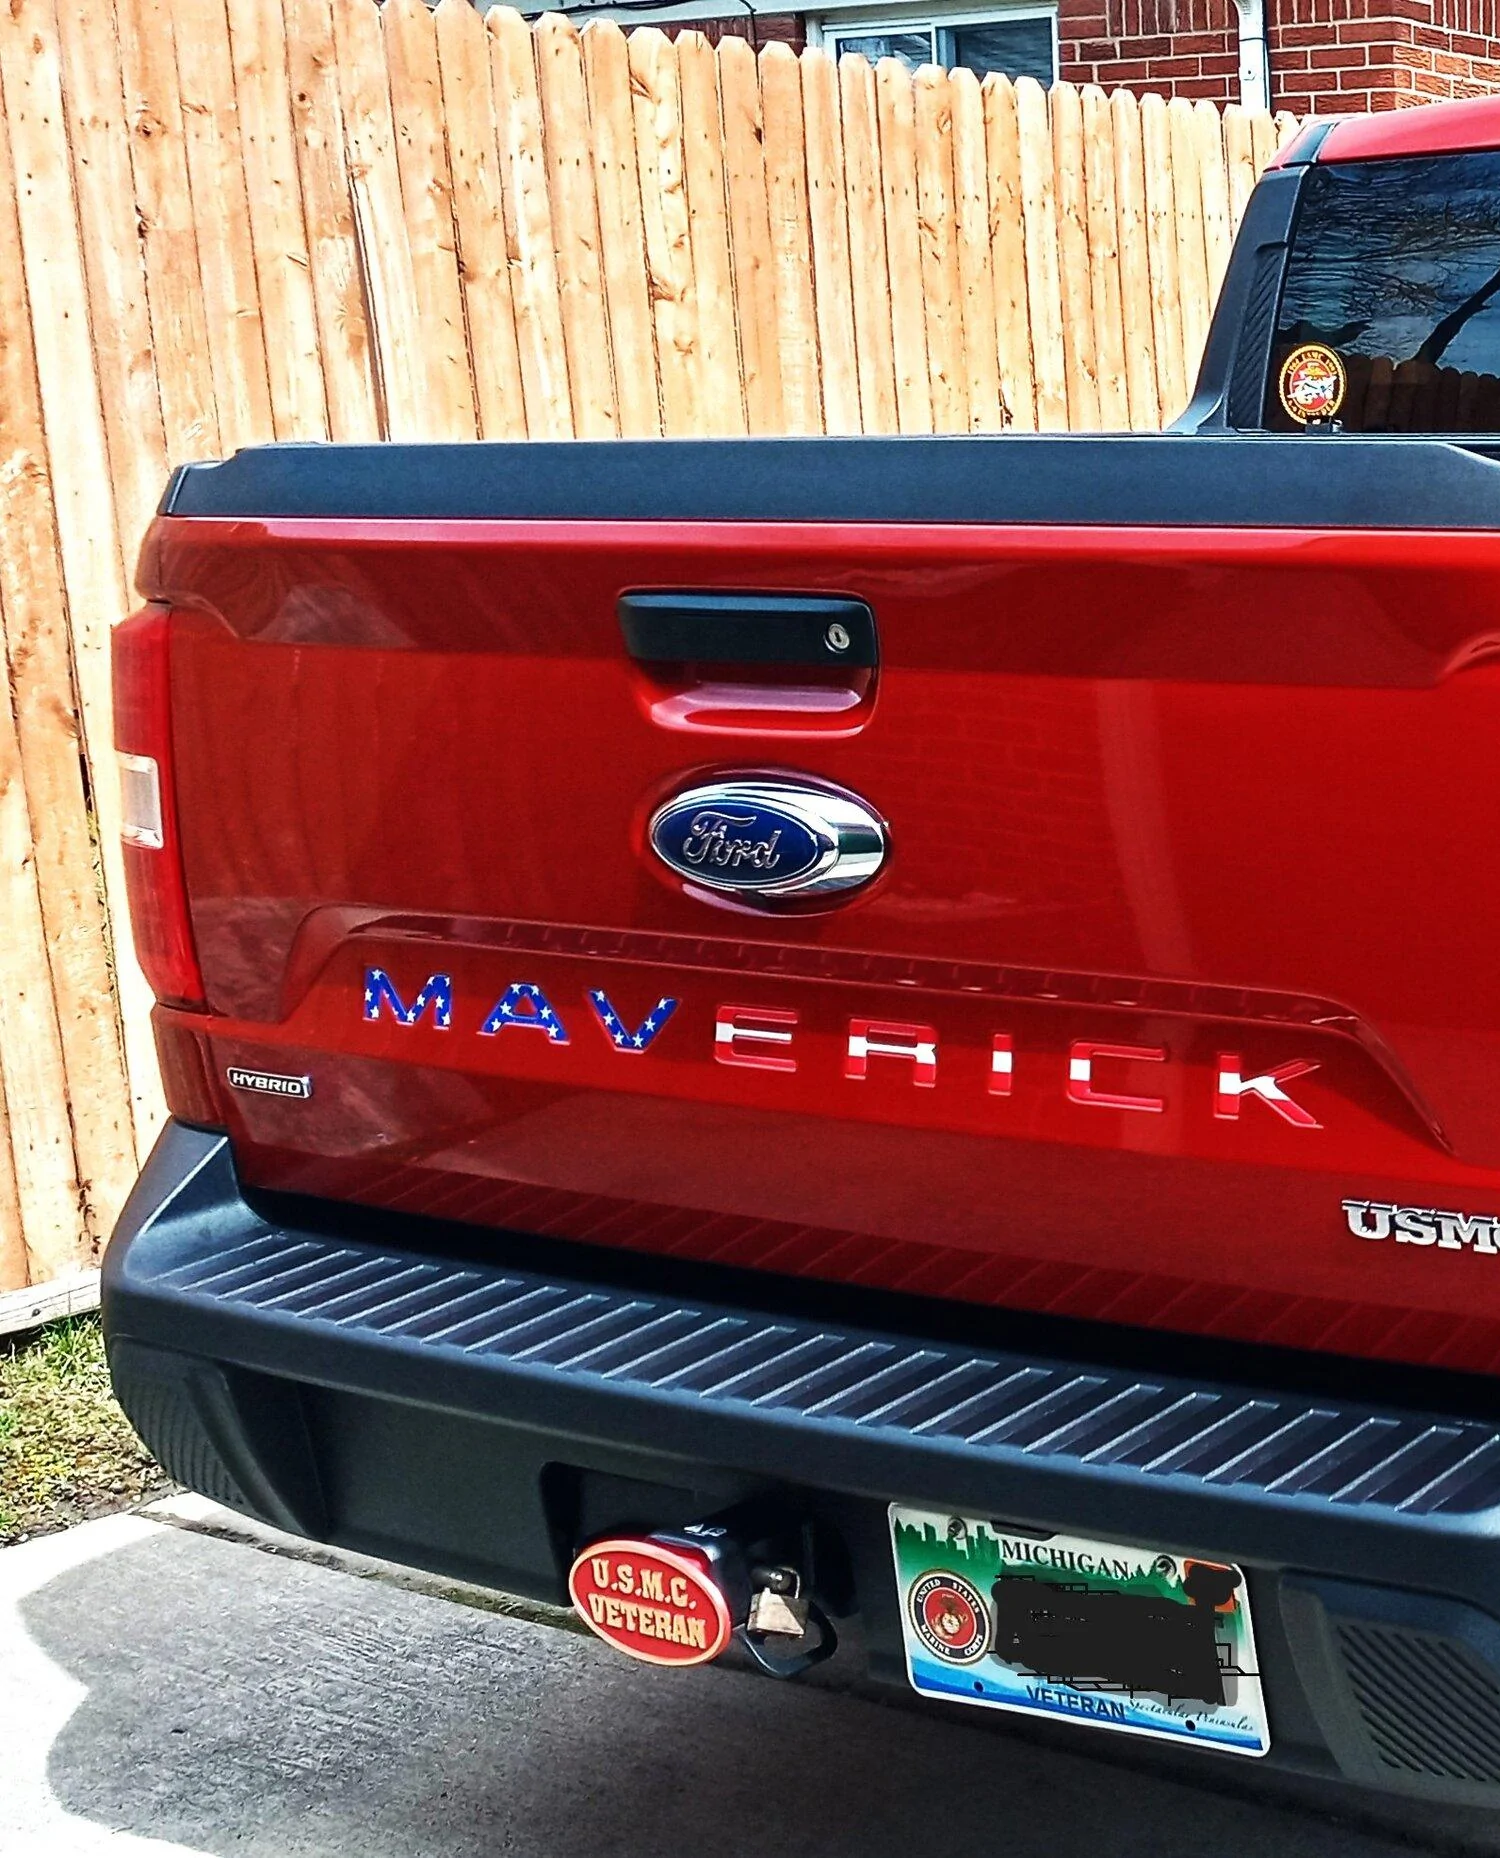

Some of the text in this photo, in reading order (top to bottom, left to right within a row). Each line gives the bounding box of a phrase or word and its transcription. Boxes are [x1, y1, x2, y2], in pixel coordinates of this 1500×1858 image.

[682, 810, 782, 869] Ford
[362, 965, 1325, 1129] MAVERICK
[232, 1072, 301, 1094] HYBRID
[1001, 1538, 1130, 1581] MICHIGAN
[591, 1558, 697, 1610] U.S.M.C.
[916, 1578, 981, 1614] UNITED STATES
[587, 1592, 707, 1650] VETERAN
[920, 1623, 984, 1656] MARINE CORPS
[1026, 1684, 1126, 1721] VETERAN
